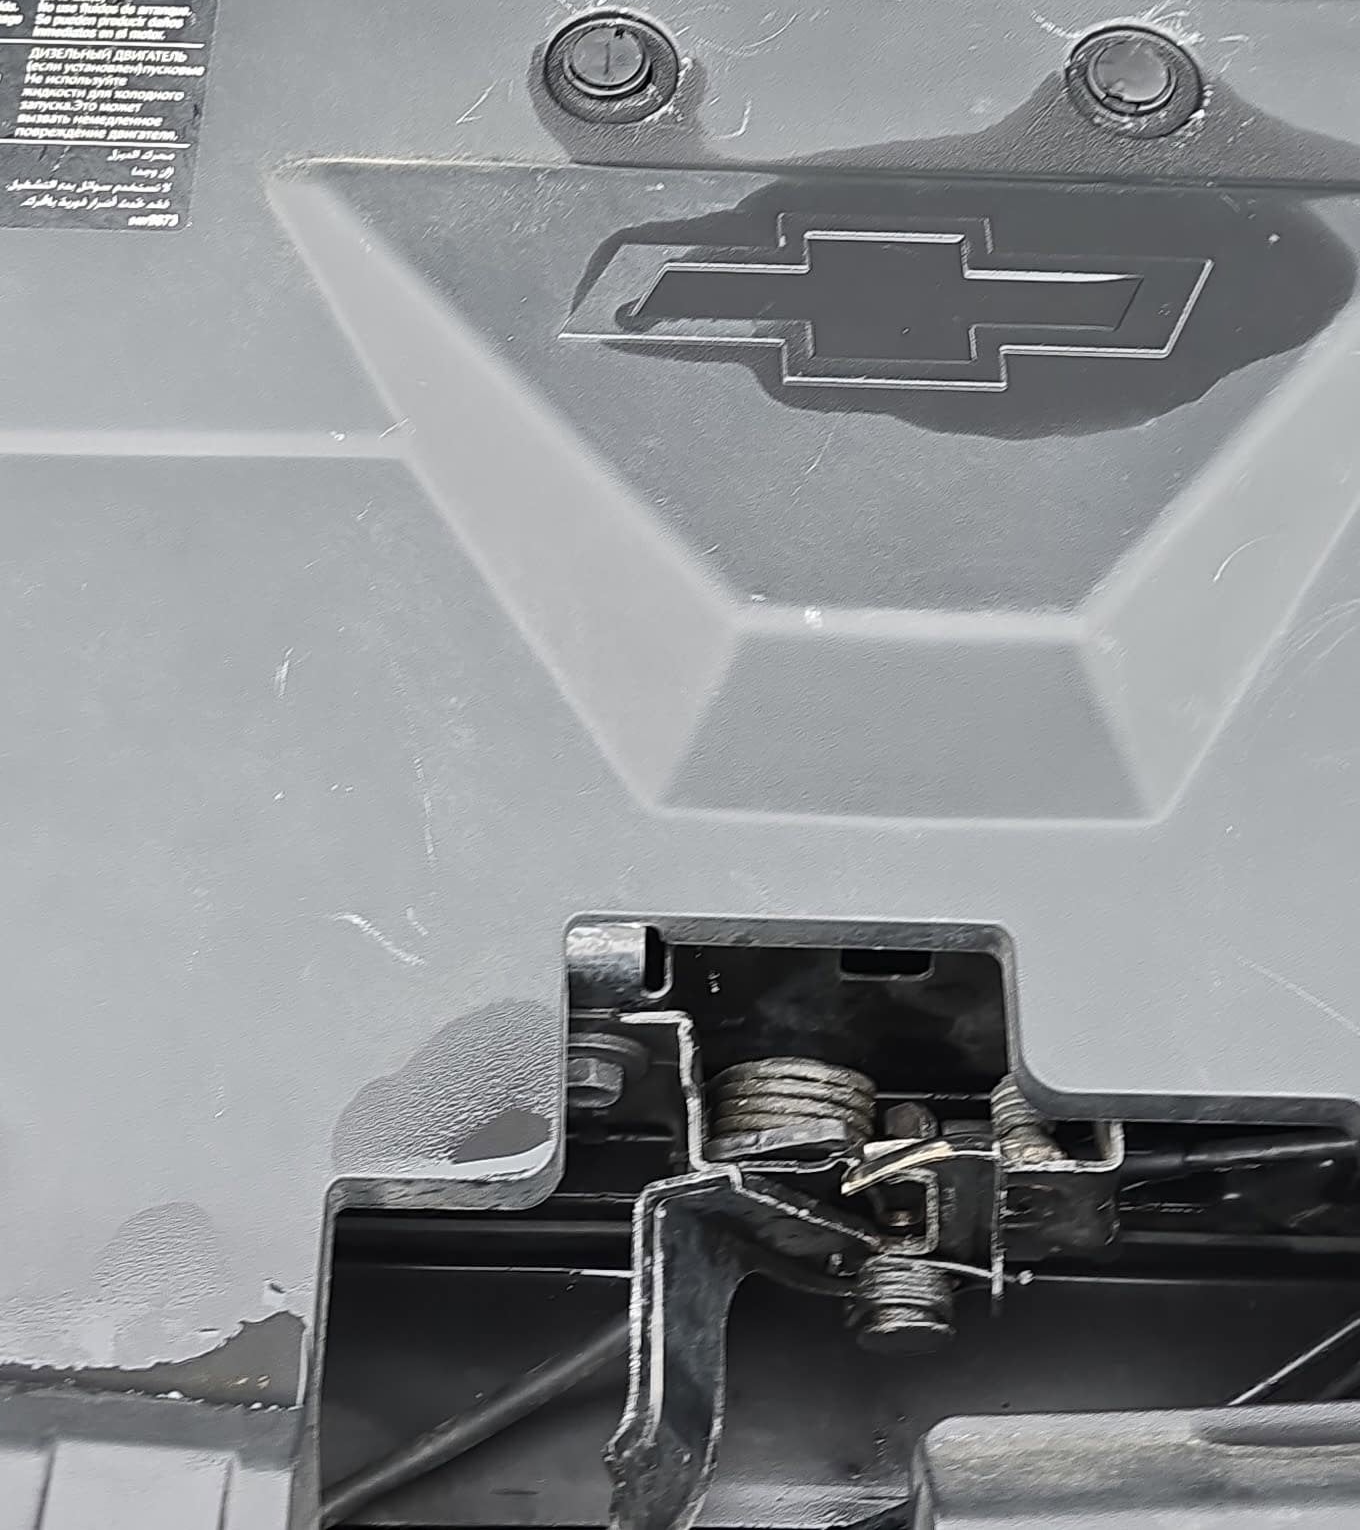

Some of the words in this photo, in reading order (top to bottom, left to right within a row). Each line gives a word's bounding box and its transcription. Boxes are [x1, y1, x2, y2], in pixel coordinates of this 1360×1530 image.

[28, 47, 112, 61] ДИЗЕЛЬНЫЙ
[112, 49, 187, 63] ДВИГАТЕЛЬ
[24, 74, 41, 84] Не
[87, 89, 112, 99] для
[112, 91, 184, 101] холодного
